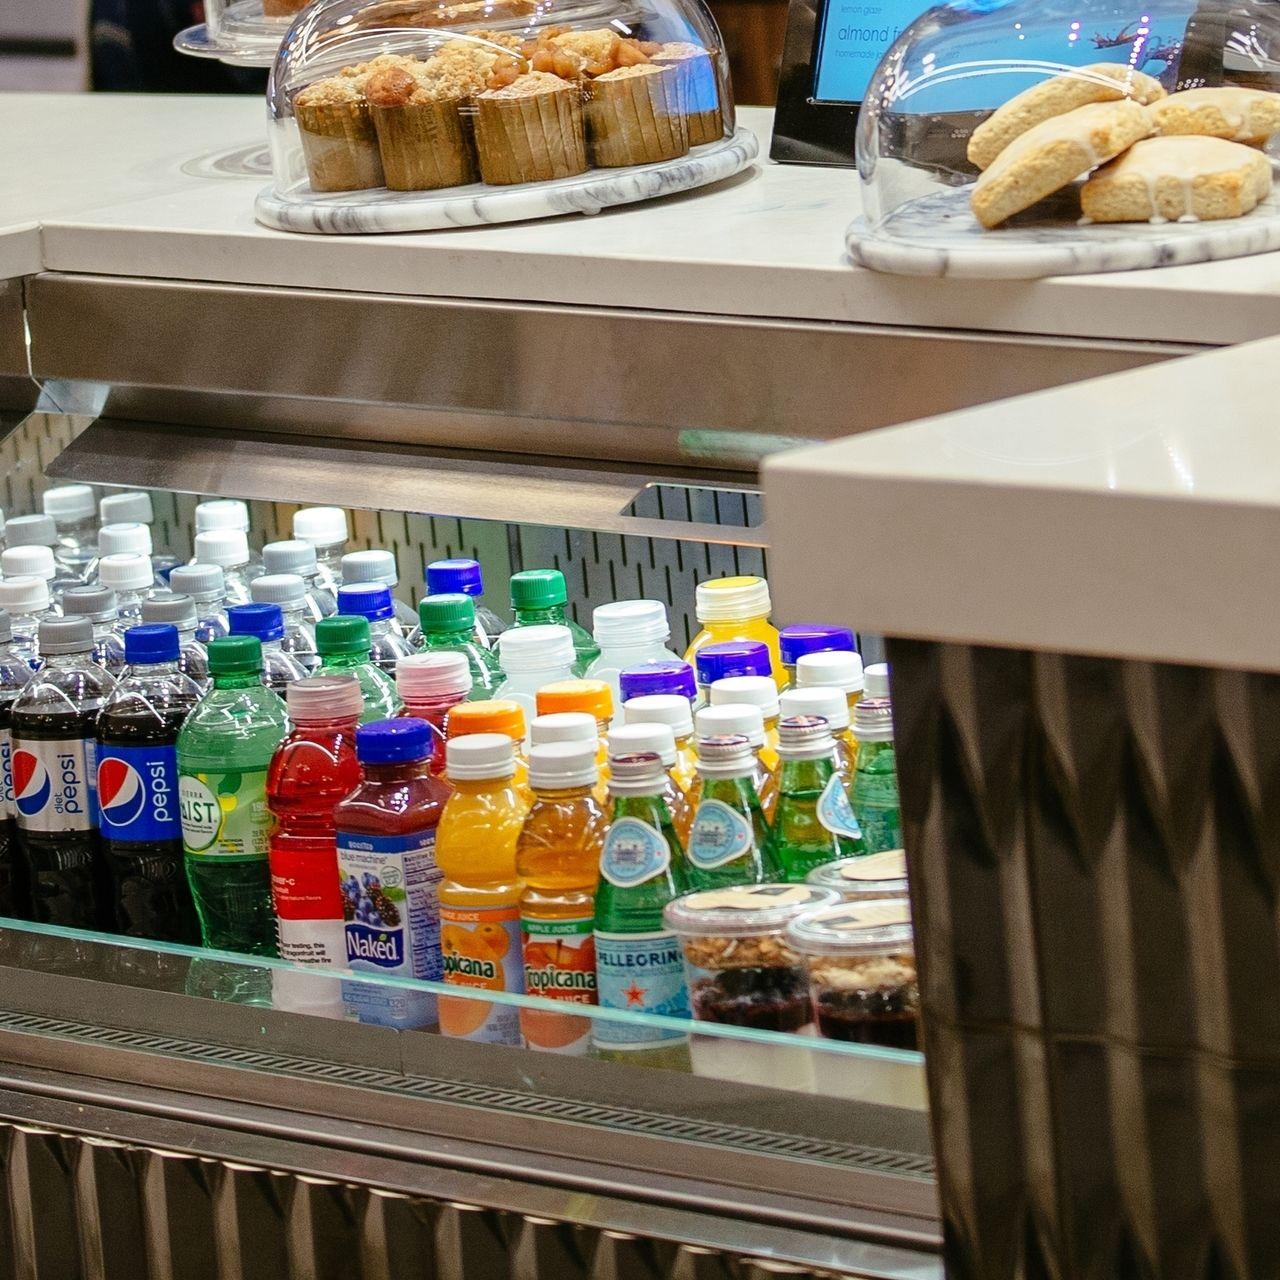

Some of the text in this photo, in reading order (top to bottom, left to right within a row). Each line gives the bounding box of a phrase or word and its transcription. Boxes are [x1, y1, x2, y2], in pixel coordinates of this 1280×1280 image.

[838, 25, 889, 42] almond
[57, 753, 83, 814] pepsi
[147, 760, 173, 822] pepsi
[54, 792, 64, 814] diet
[443, 951, 495, 979] opicana
